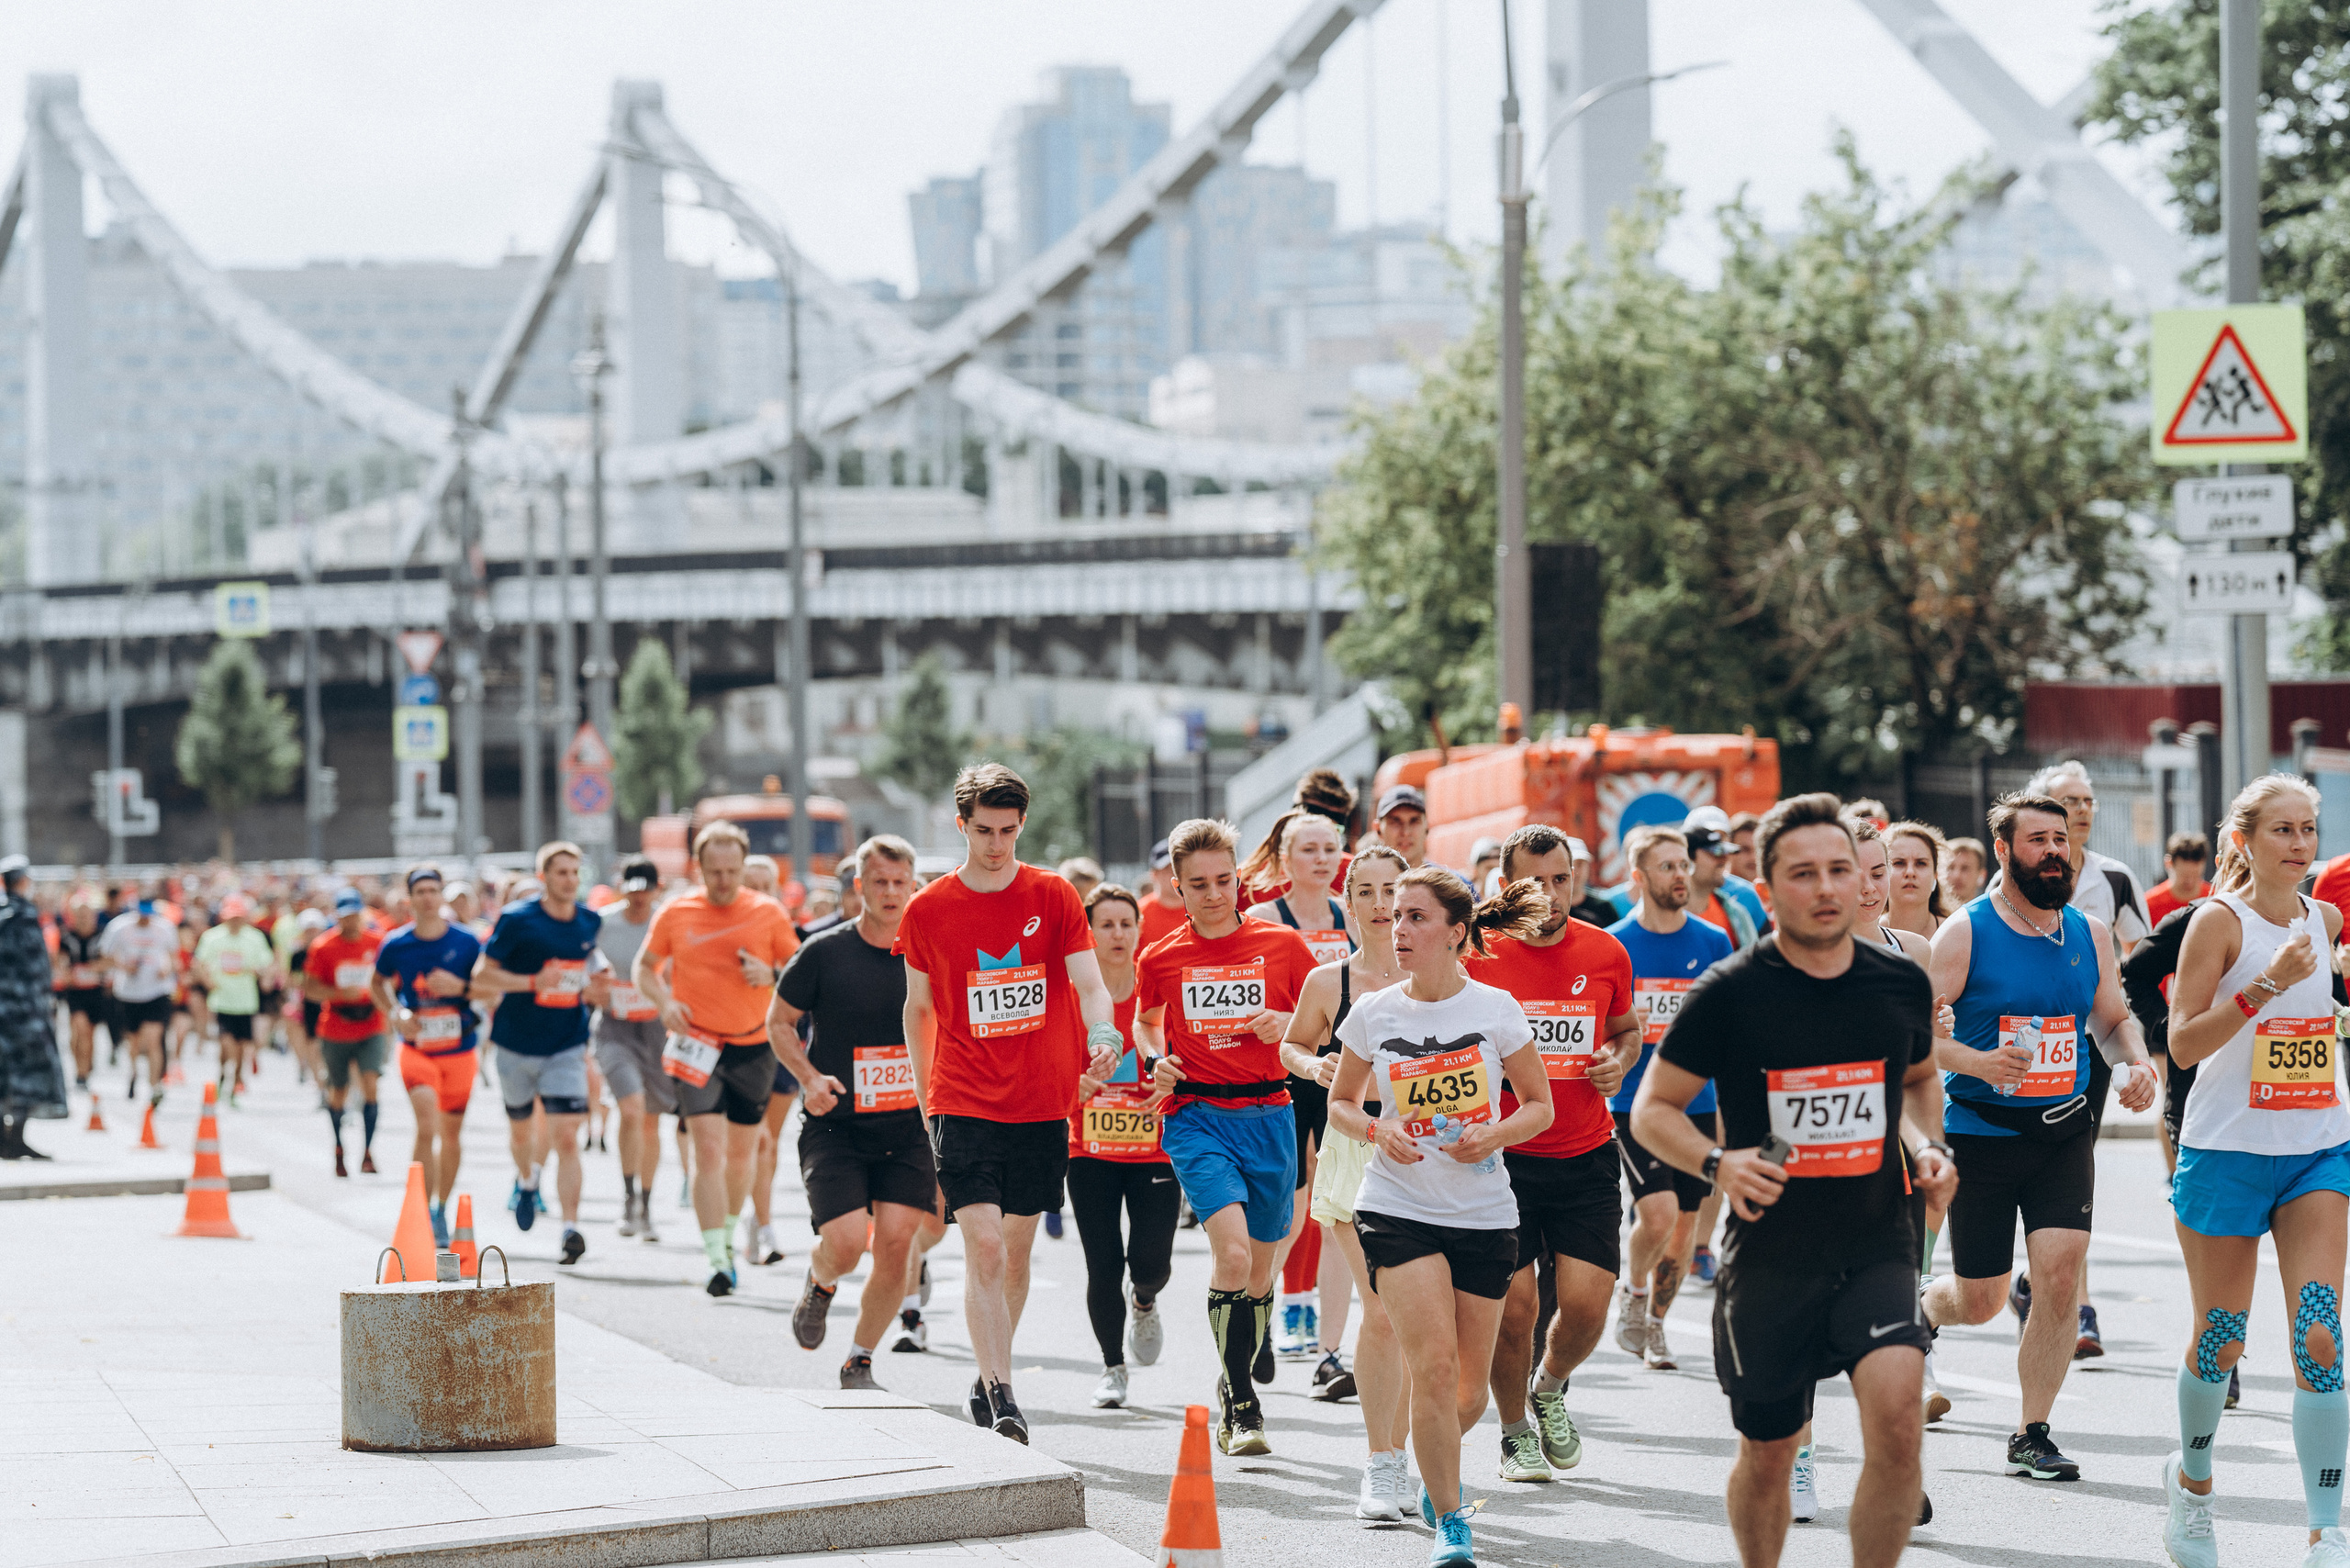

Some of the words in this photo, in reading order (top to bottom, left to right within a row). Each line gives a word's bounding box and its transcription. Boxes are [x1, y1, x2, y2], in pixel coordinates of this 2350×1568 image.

[973, 983, 1043, 1013] 11528
[1188, 983, 1261, 1008] 12438
[991, 1010, 1030, 1020] ВСЕВОЛОД
[979, 1025, 989, 1036] D
[1193, 1021, 1203, 1033] D
[1209, 1041, 1241, 1051] МАРАФОН
[2268, 1040, 2327, 1069] 5358
[1443, 1058, 1458, 1067] 21,1
[1408, 1070, 1478, 1106] 4635
[2261, 1084, 2273, 1100] D
[1435, 1104, 1459, 1114] OLGA
[1787, 1092, 1872, 1128] 7574
[1411, 1122, 1424, 1137] D
[1090, 1141, 1100, 1154] D
